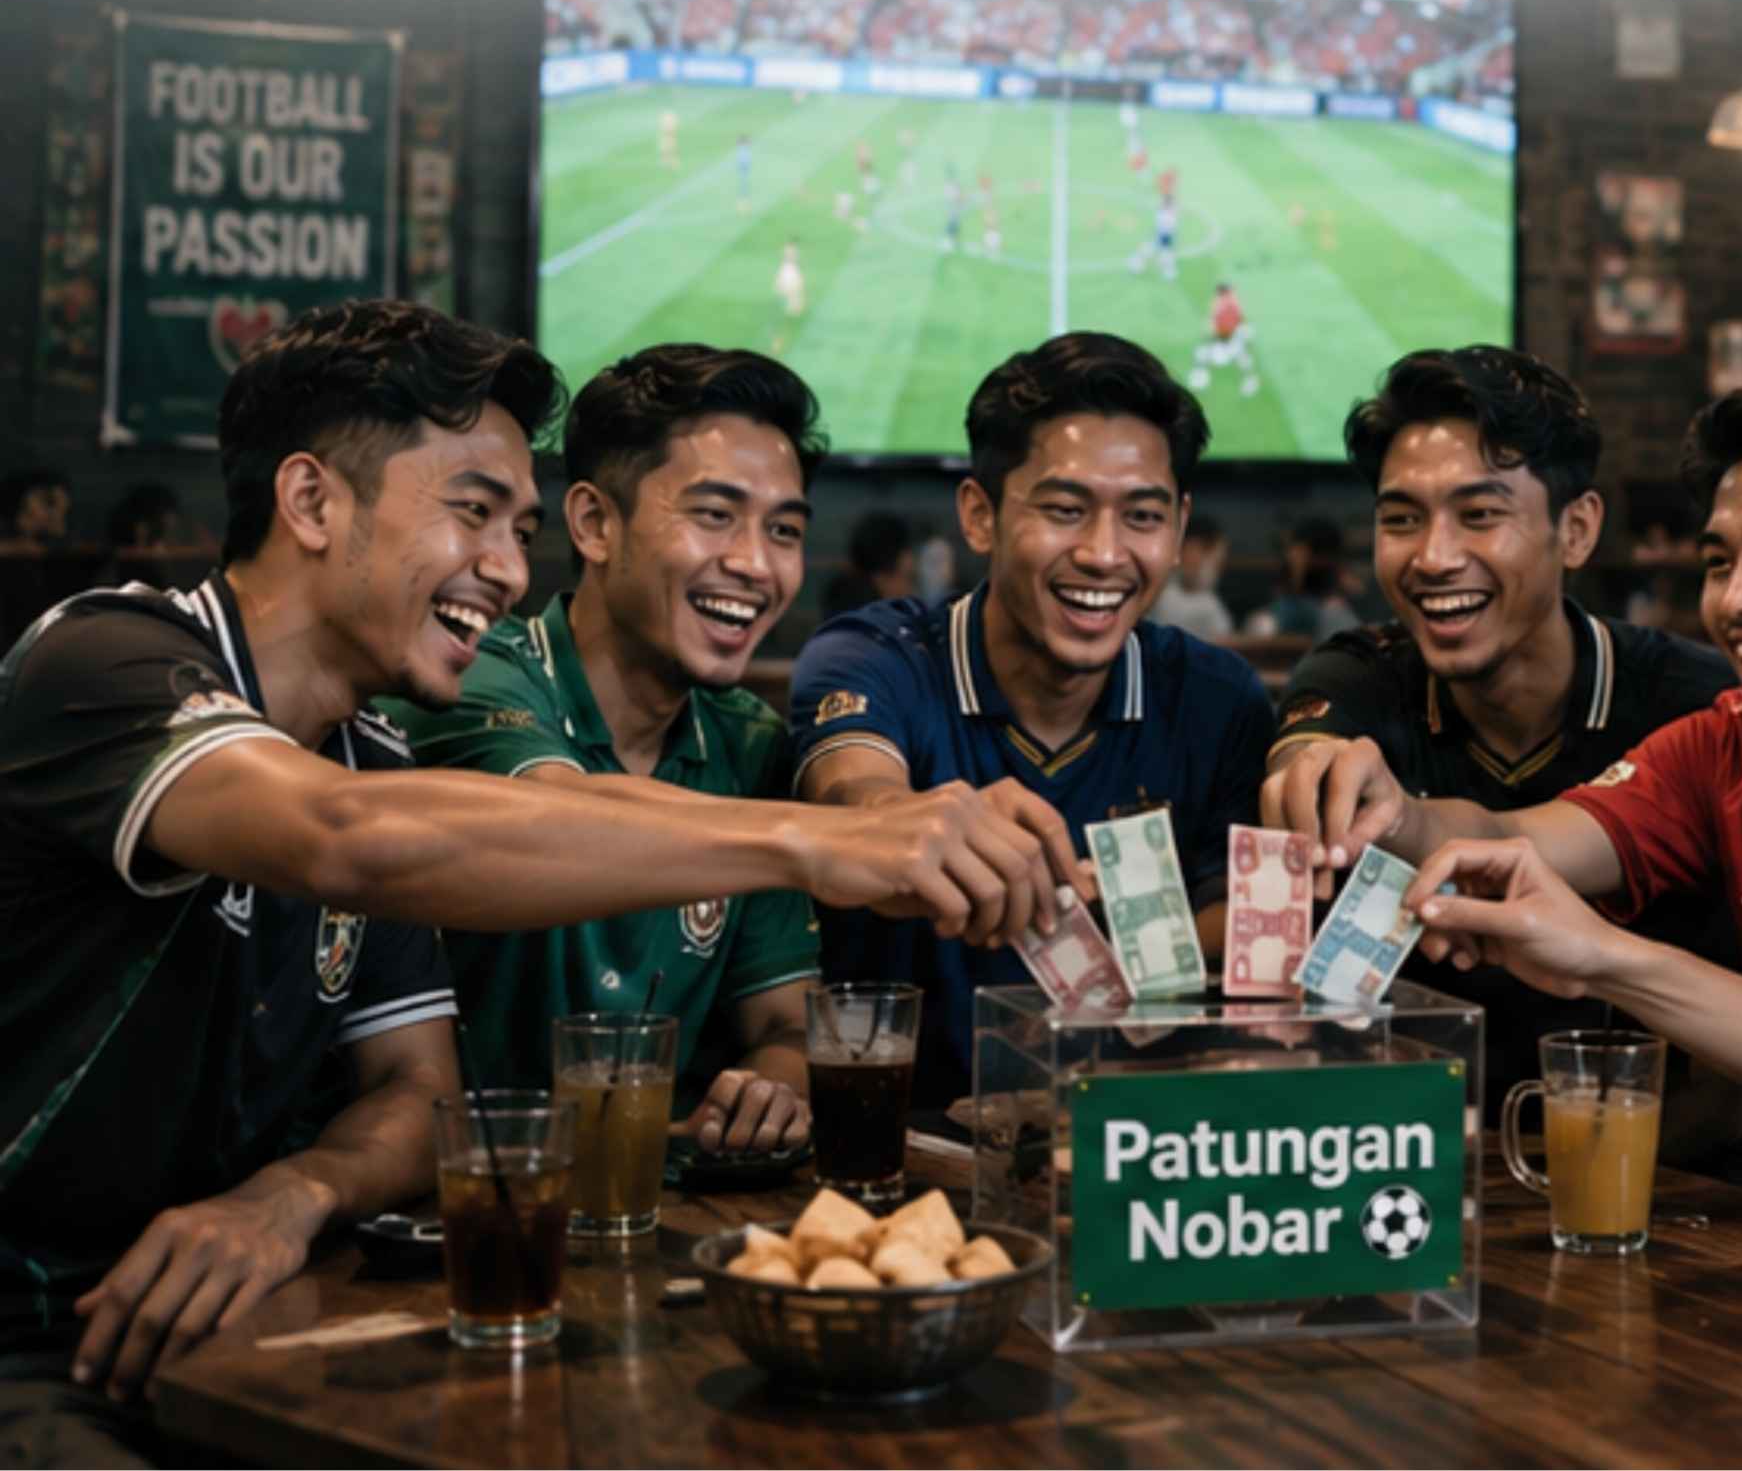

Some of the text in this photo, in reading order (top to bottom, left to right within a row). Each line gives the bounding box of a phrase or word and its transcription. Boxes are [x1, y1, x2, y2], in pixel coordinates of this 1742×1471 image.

[149, 61, 371, 133] FOOTBALL
[173, 132, 346, 203] IS OUR
[143, 204, 370, 279] PASSION
[1104, 1119, 1435, 1189] Patungan
[1130, 1194, 1343, 1262] Nobar
